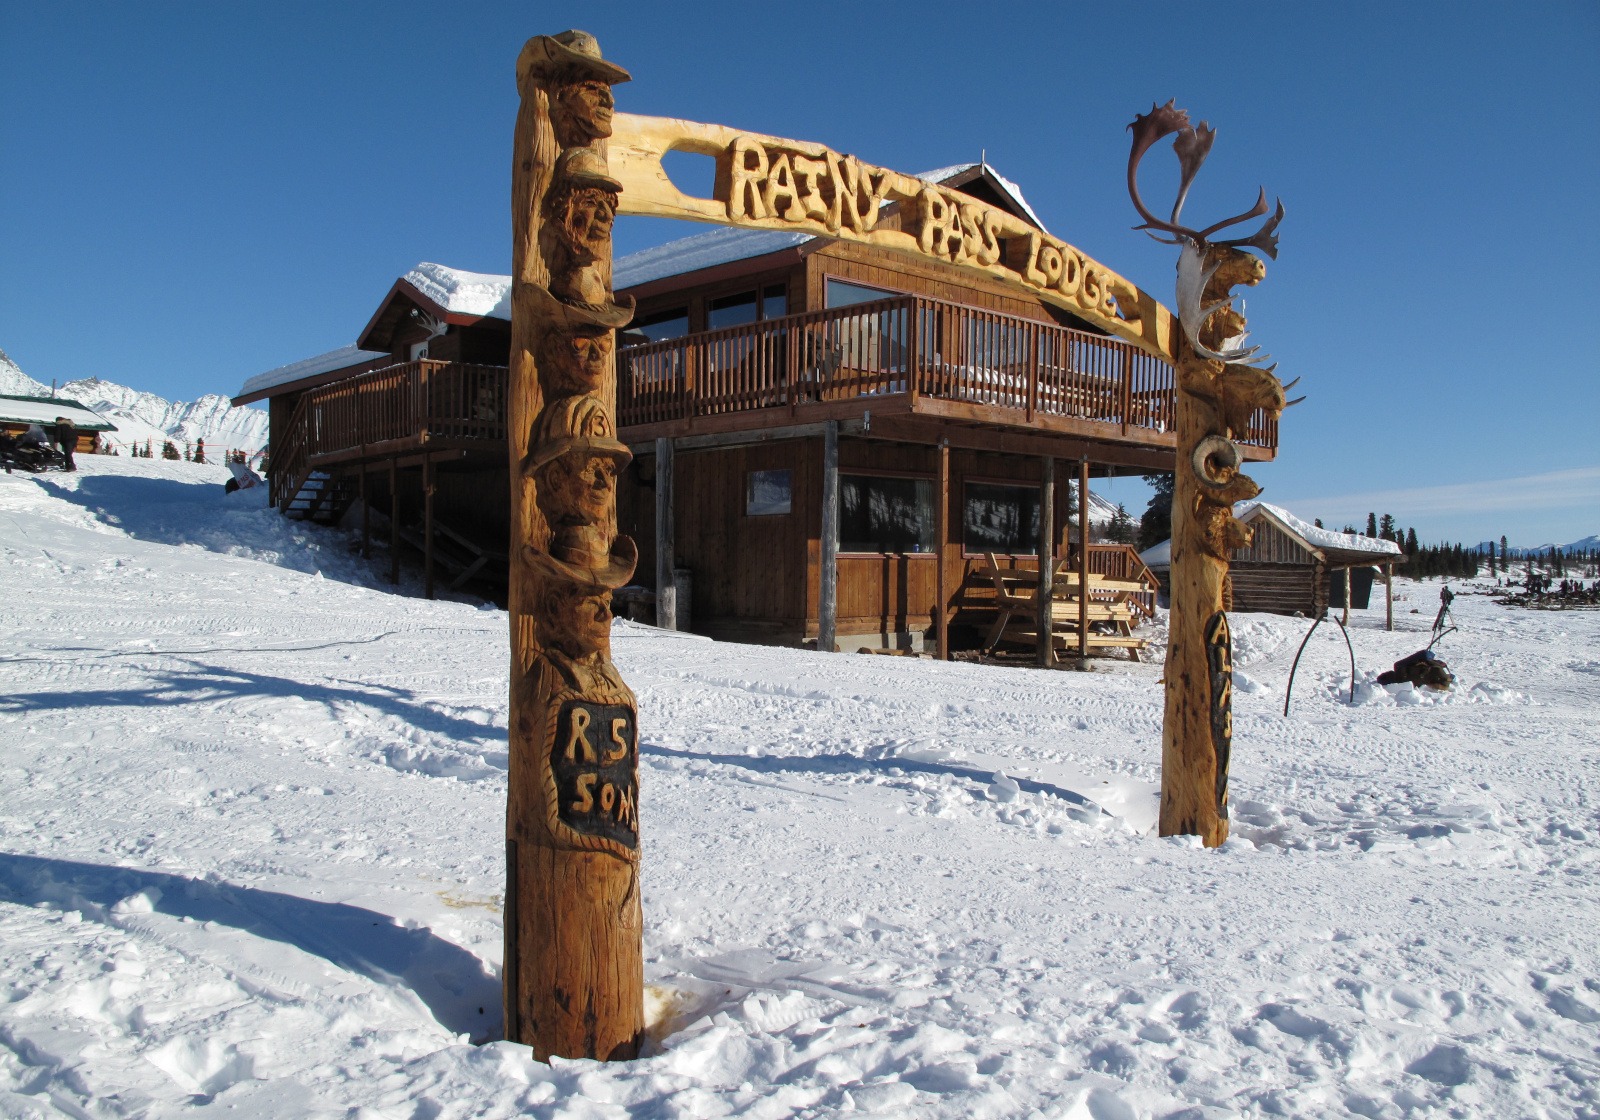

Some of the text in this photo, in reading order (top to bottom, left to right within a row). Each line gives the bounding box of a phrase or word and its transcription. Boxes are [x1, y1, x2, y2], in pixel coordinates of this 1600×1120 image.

[730, 136, 1117, 317] RAINY PASS LODGE
